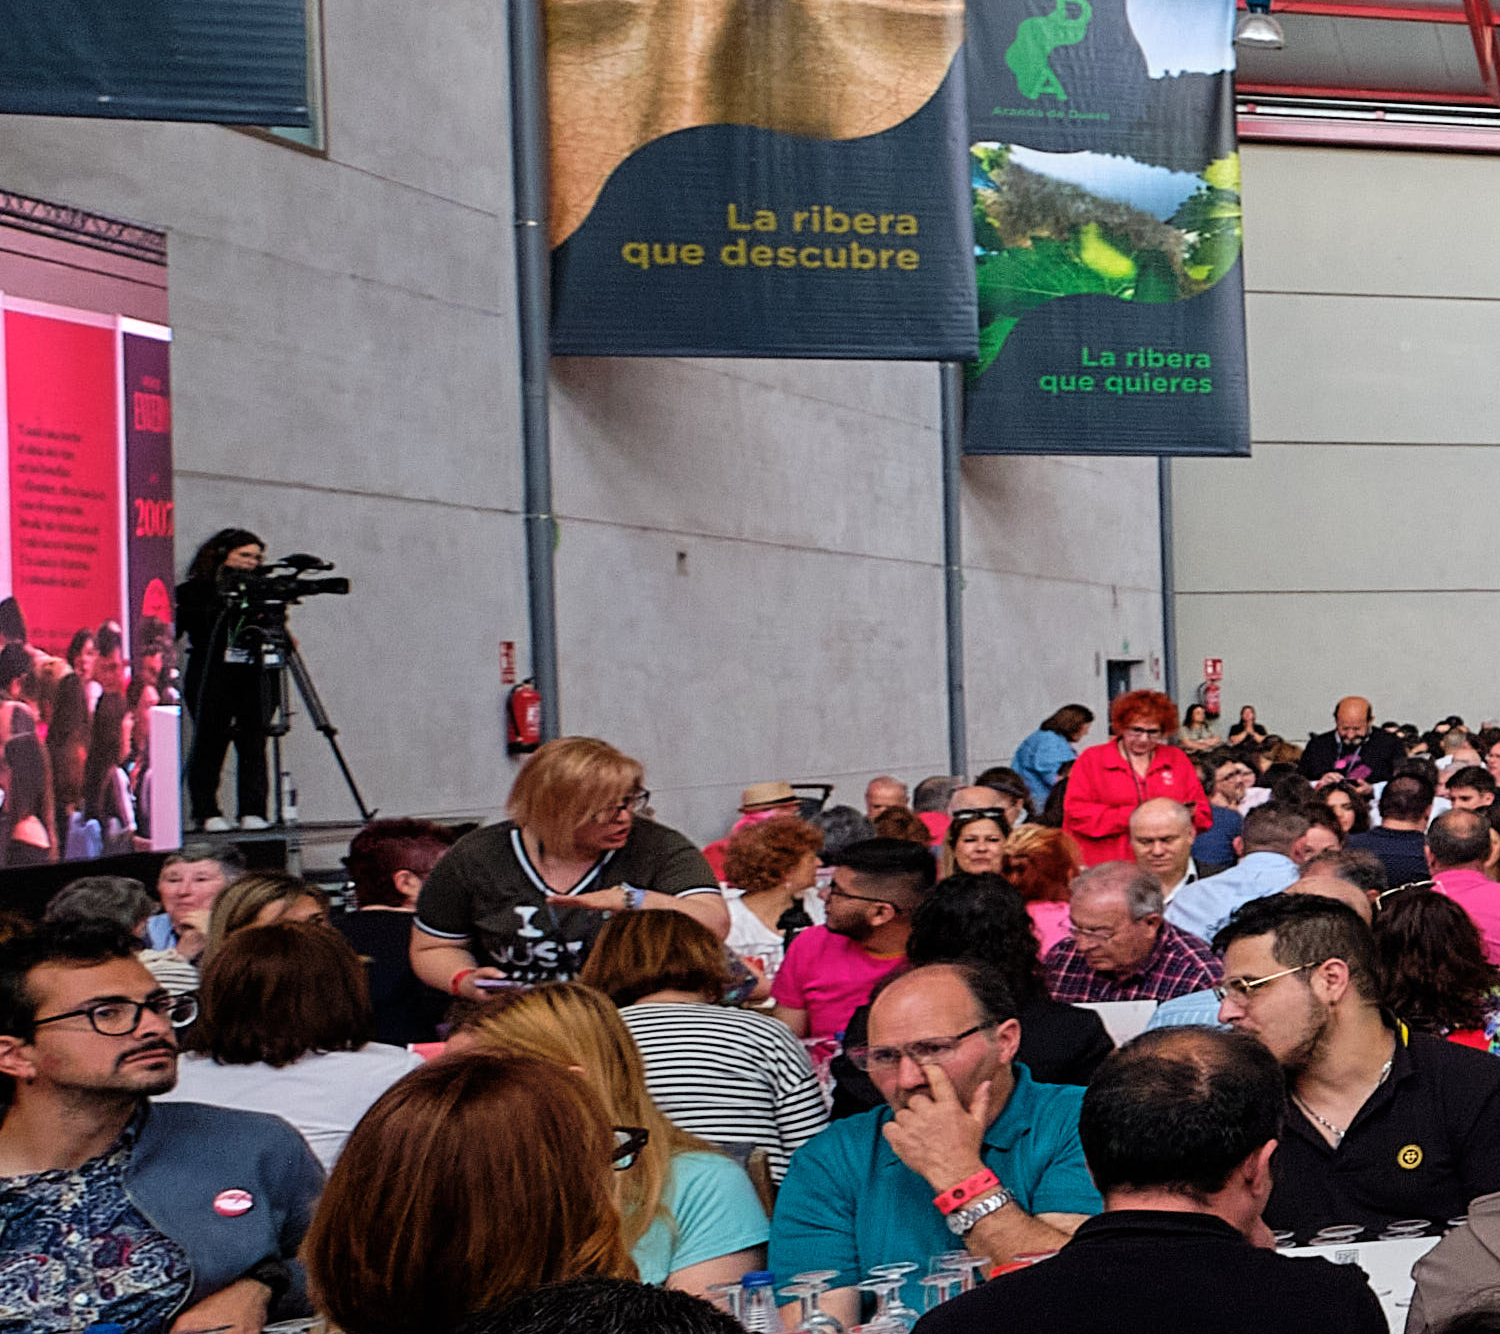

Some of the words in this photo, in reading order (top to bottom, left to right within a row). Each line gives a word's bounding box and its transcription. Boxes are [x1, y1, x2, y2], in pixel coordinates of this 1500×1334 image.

[727, 203, 778, 231] La
[792, 205, 919, 236] ribera
[621, 241, 706, 270] que
[720, 238, 920, 271] descubre
[1083, 347, 1116, 367] La
[1126, 348, 1212, 369] ribera
[1039, 373, 1095, 395] que
[1104, 372, 1213, 395] quieres
